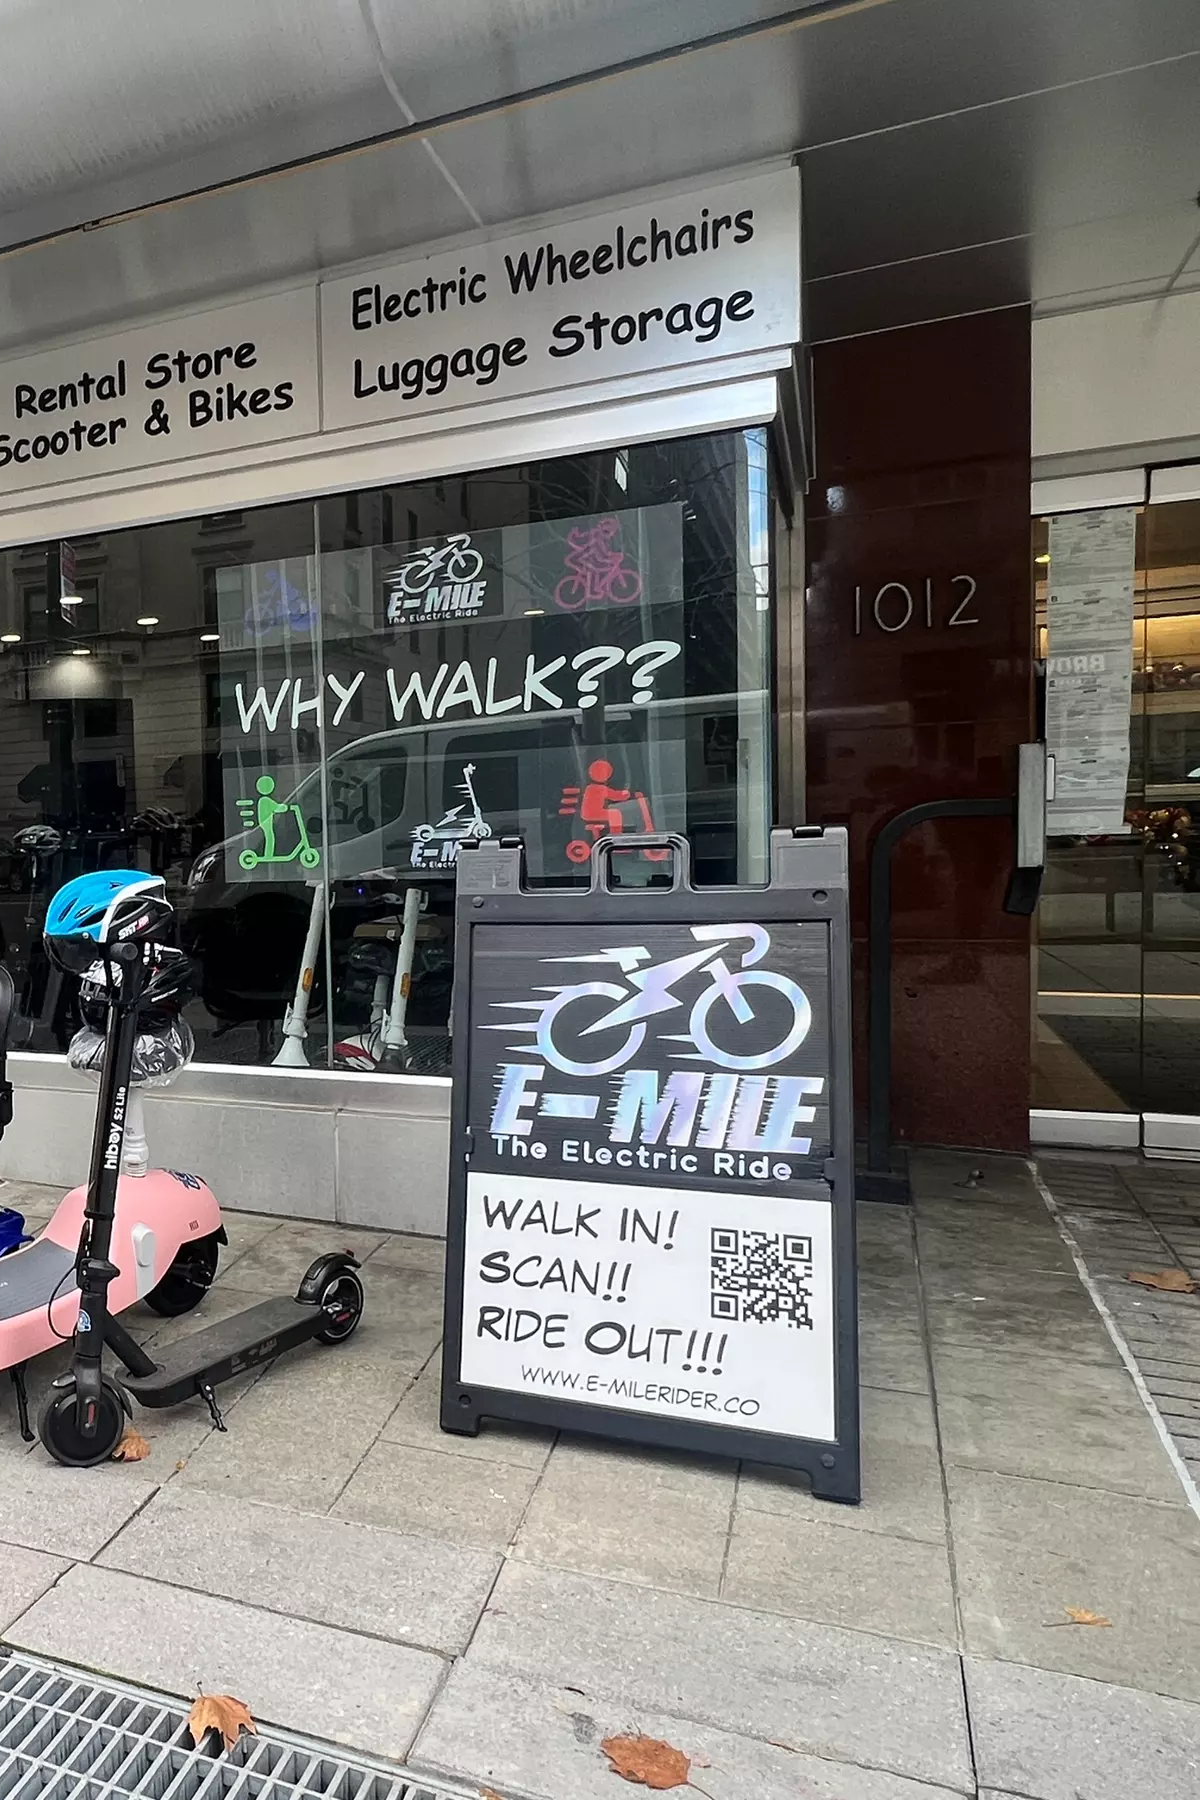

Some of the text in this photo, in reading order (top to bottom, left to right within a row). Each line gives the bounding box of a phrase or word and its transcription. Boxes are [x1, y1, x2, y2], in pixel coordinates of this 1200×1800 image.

[351, 208, 755, 332] Electric Wheelchairs
[353, 288, 755, 400] Luggage Storage
[14, 341, 258, 420] Rental Store
[142, 397, 172, 437] &
[187, 380, 295, 429] Bikes
[387, 580, 488, 618] E-MILE
[409, 611, 452, 623] Electric
[855, 574, 980, 636] 1012
[234, 639, 683, 735] WHY WALK??
[103, 1086, 127, 1170] hiboy S2 Lite
[490, 1062, 825, 1155] E-MILE
[491, 1134, 794, 1181] The Electric Ride
[482, 1194, 680, 1251] WALK IN!
[478, 1249, 633, 1303] SCAN!!
[476, 1304, 729, 1377] RIDE OUT!!!
[520, 1363, 762, 1418] WWW.E-MILERIDER.CO
